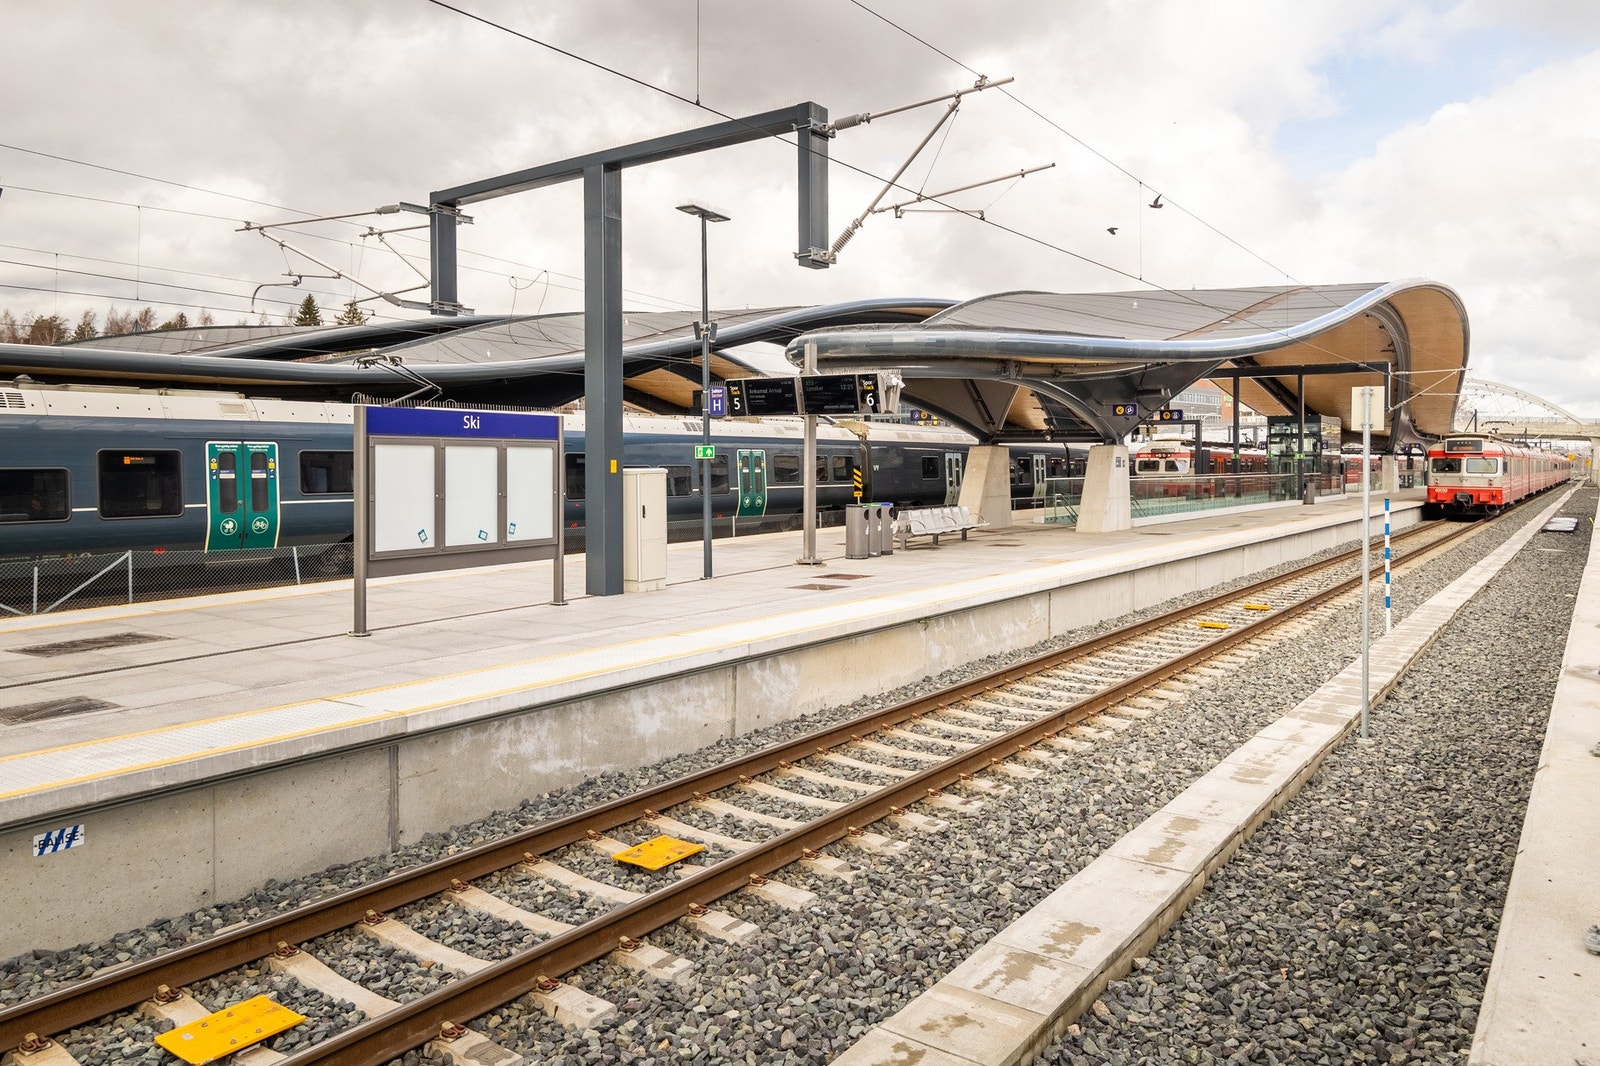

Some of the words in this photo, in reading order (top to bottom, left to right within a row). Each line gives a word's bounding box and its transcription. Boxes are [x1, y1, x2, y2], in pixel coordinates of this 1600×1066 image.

[713, 399, 721, 412] H
[734, 398, 741, 410] 5
[866, 393, 875, 406] 6
[463, 415, 480, 429] Ski
[38, 830, 80, 850] BALISE
